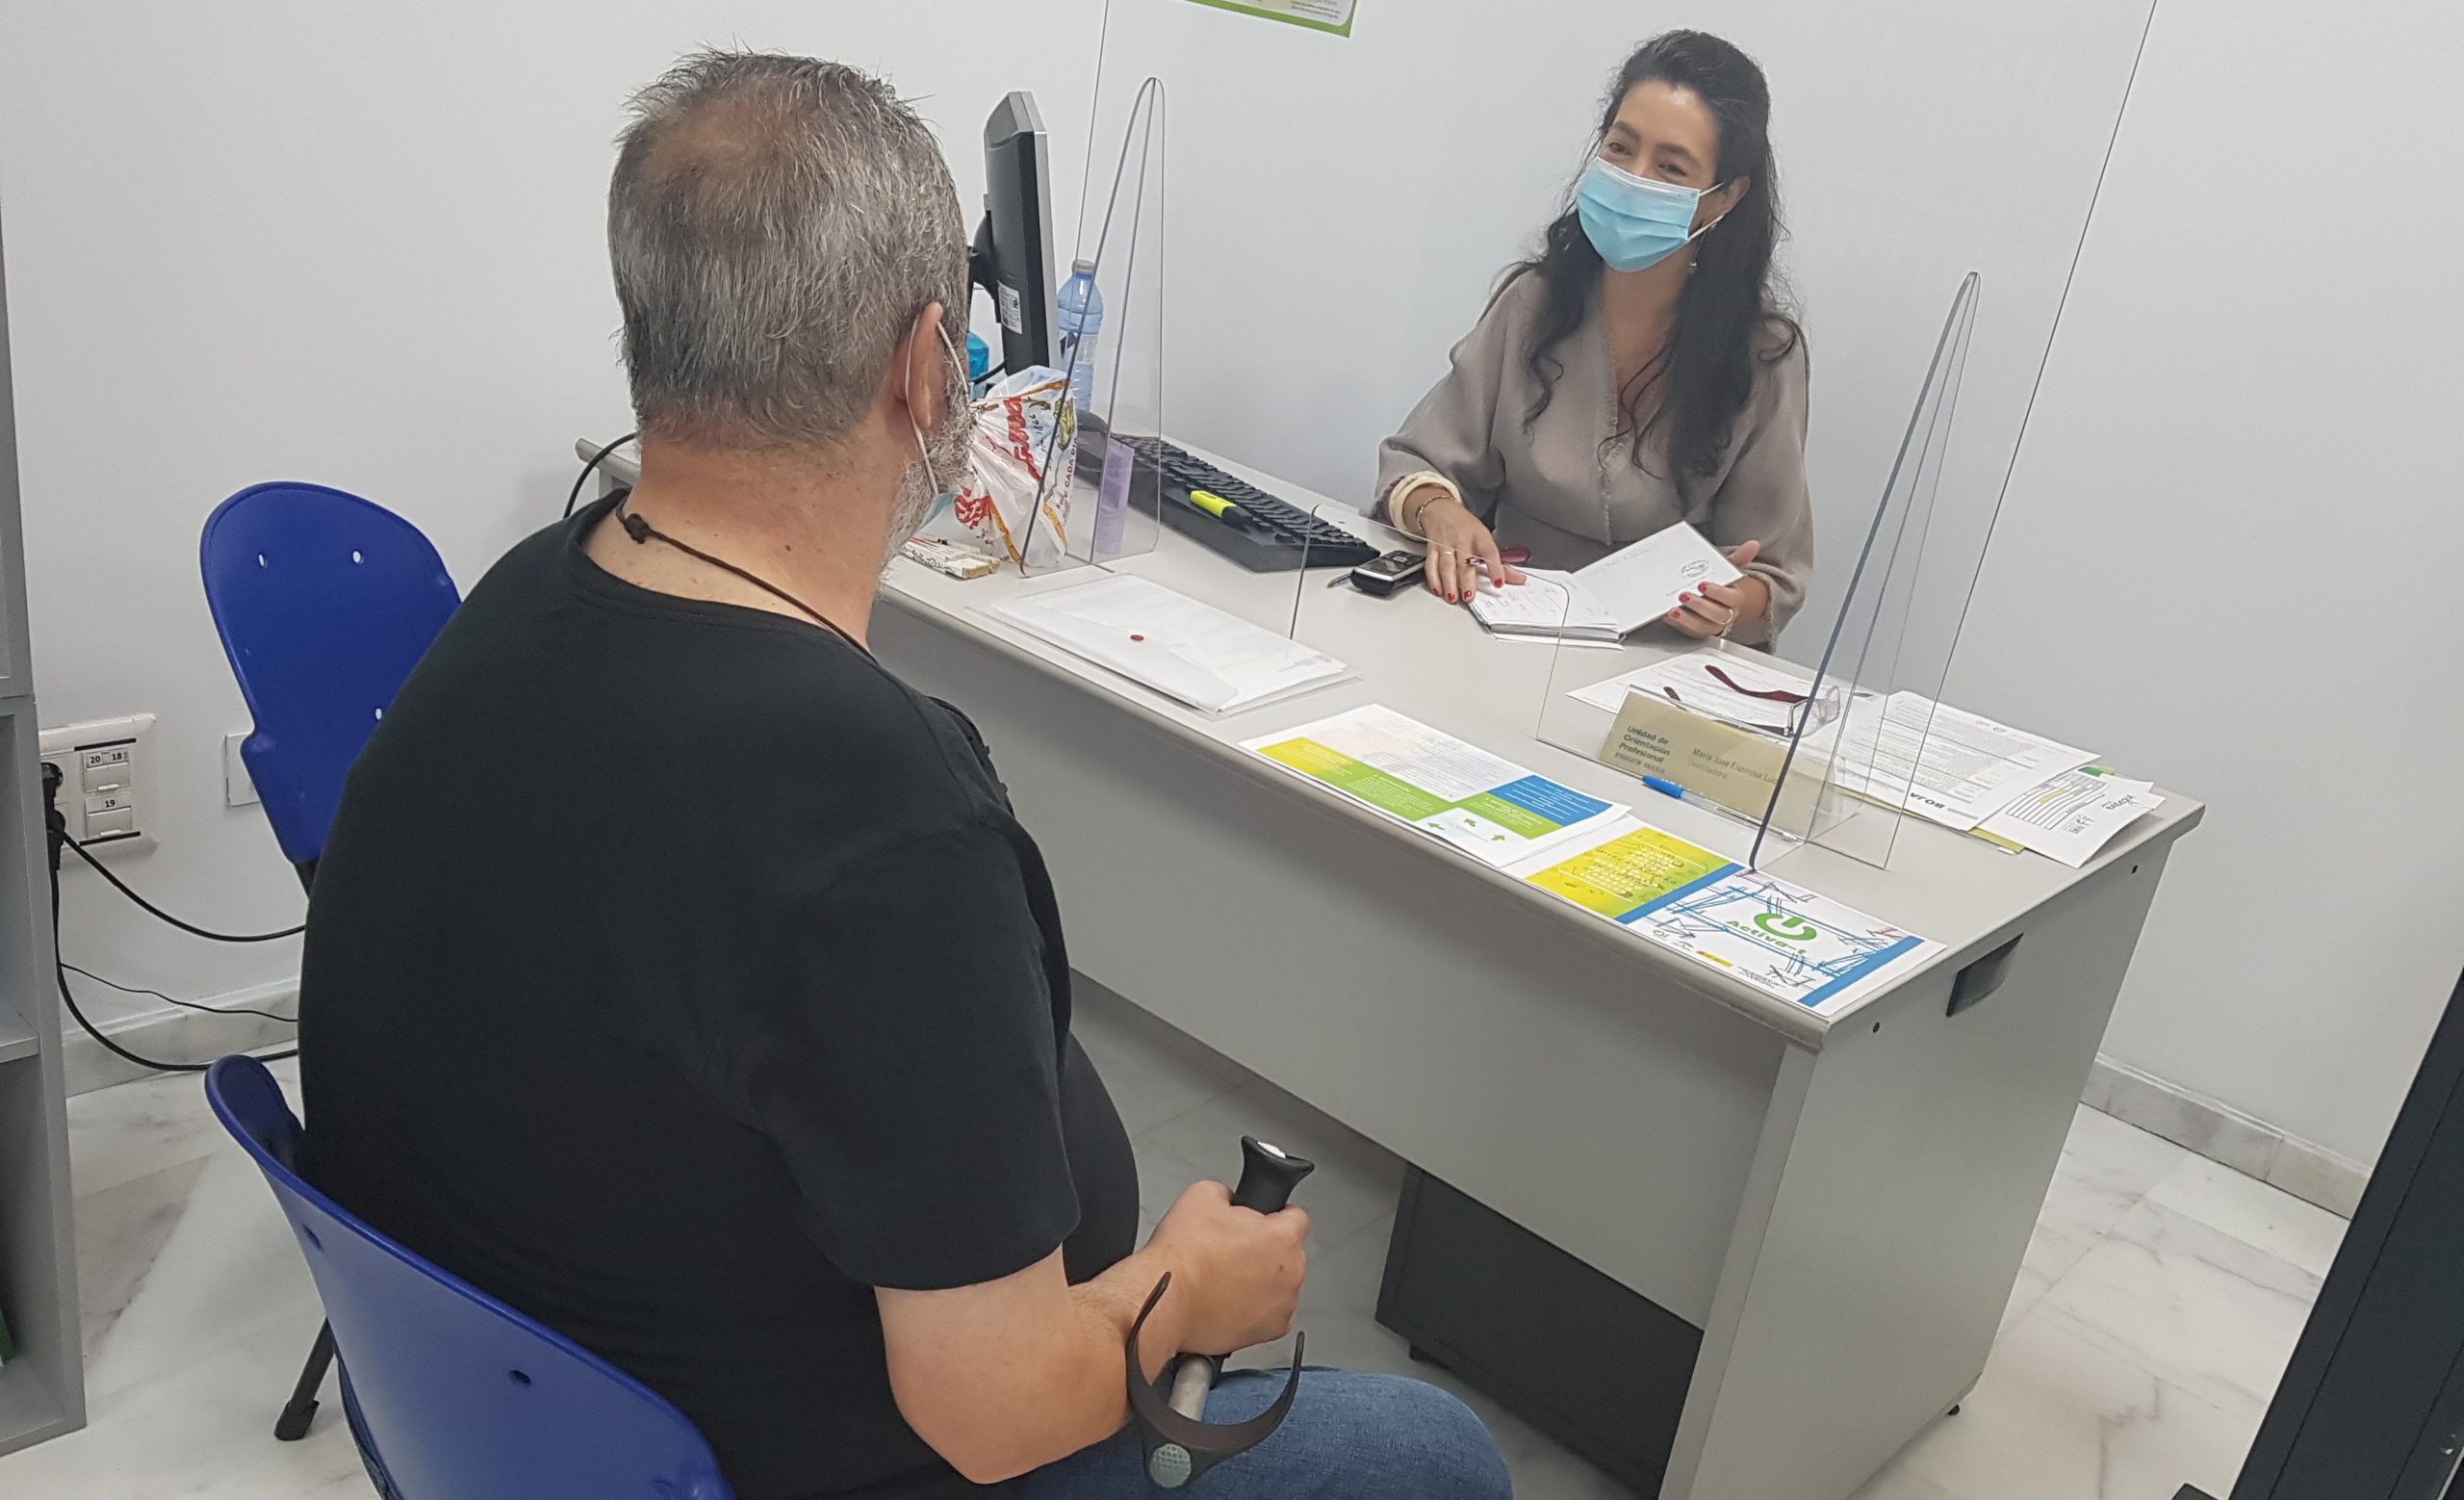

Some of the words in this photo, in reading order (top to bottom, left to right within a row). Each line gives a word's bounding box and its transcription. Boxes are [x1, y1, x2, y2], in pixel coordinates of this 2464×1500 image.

[1065, 458, 1075, 488] CADA
[1628, 725, 1657, 741] Unidad
[1657, 737, 1669, 746] de
[90, 755, 101, 764] 20
[112, 752, 122, 761] 18
[1619, 741, 1665, 763] Profesional
[105, 799, 116, 809] 19
[1910, 792, 1945, 810] BOJA
